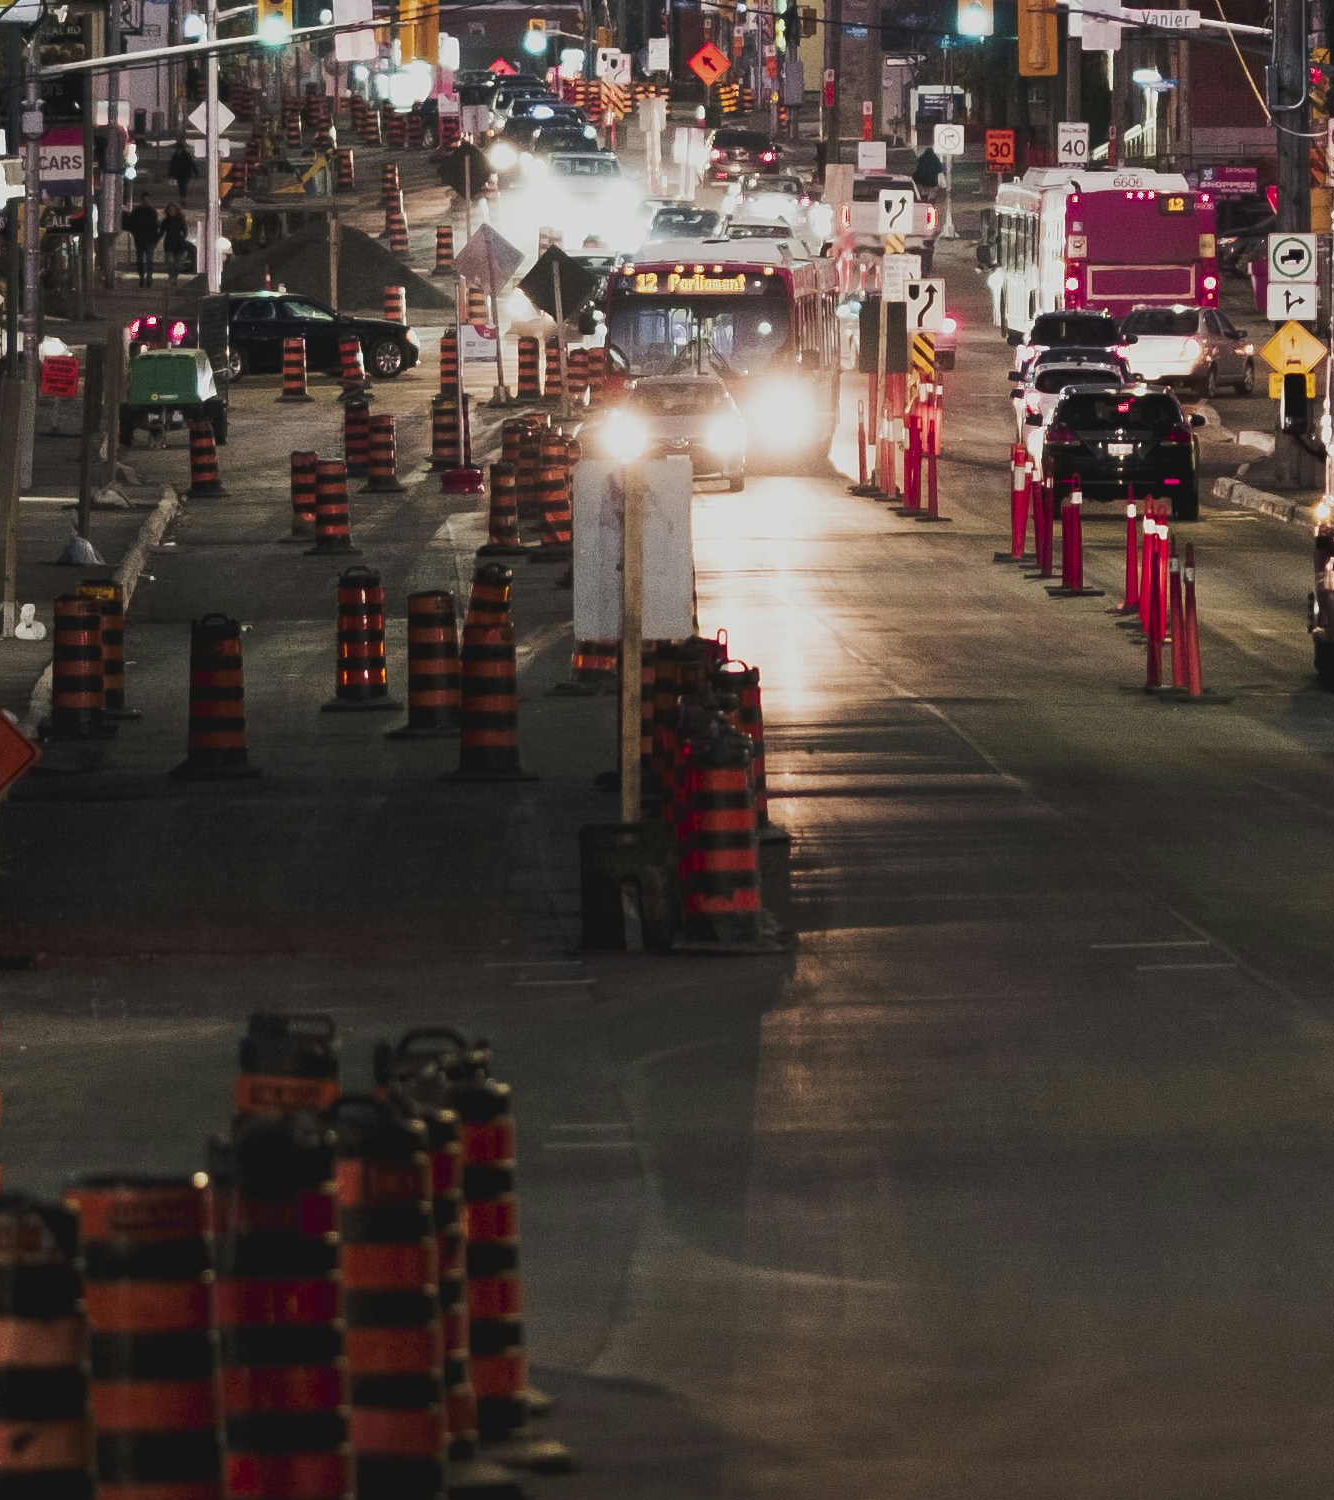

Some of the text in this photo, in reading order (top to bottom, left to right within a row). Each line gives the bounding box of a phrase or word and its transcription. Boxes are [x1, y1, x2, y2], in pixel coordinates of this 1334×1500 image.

[1142, 11, 1190, 28] Vanier
[989, 142, 1011, 158] 30
[1062, 140, 1086, 156] 40
[1168, 197, 1185, 212] 12
[636, 272, 658, 293] 12
